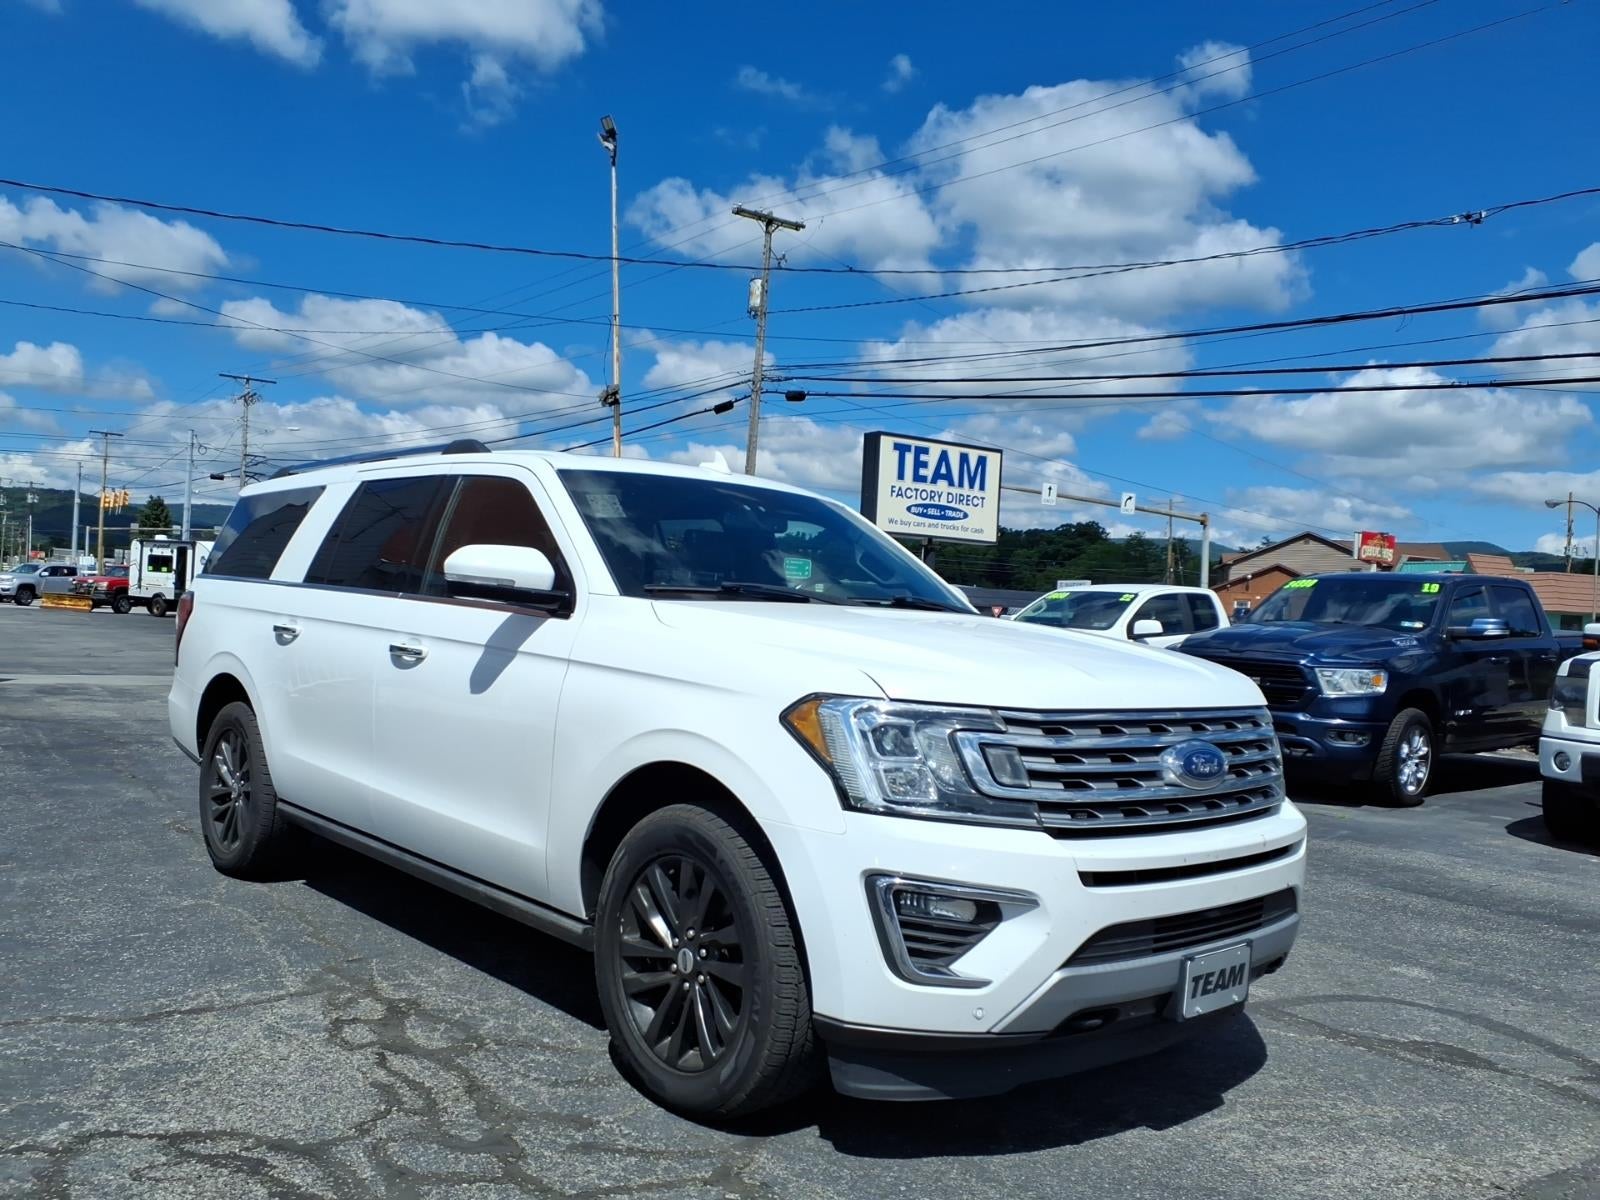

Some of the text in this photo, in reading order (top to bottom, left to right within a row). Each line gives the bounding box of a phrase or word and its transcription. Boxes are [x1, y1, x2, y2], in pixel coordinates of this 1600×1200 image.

[893, 442, 987, 492] TEAM
[890, 485, 986, 508] FACTORY DIRECT
[910, 506, 964, 518] BUY SELL TRADE
[899, 519, 912, 527] buy
[940, 523, 959, 531] trucks
[961, 525, 969, 533] for
[1191, 753, 1219, 773] Ford
[1191, 962, 1246, 999] TEAM
